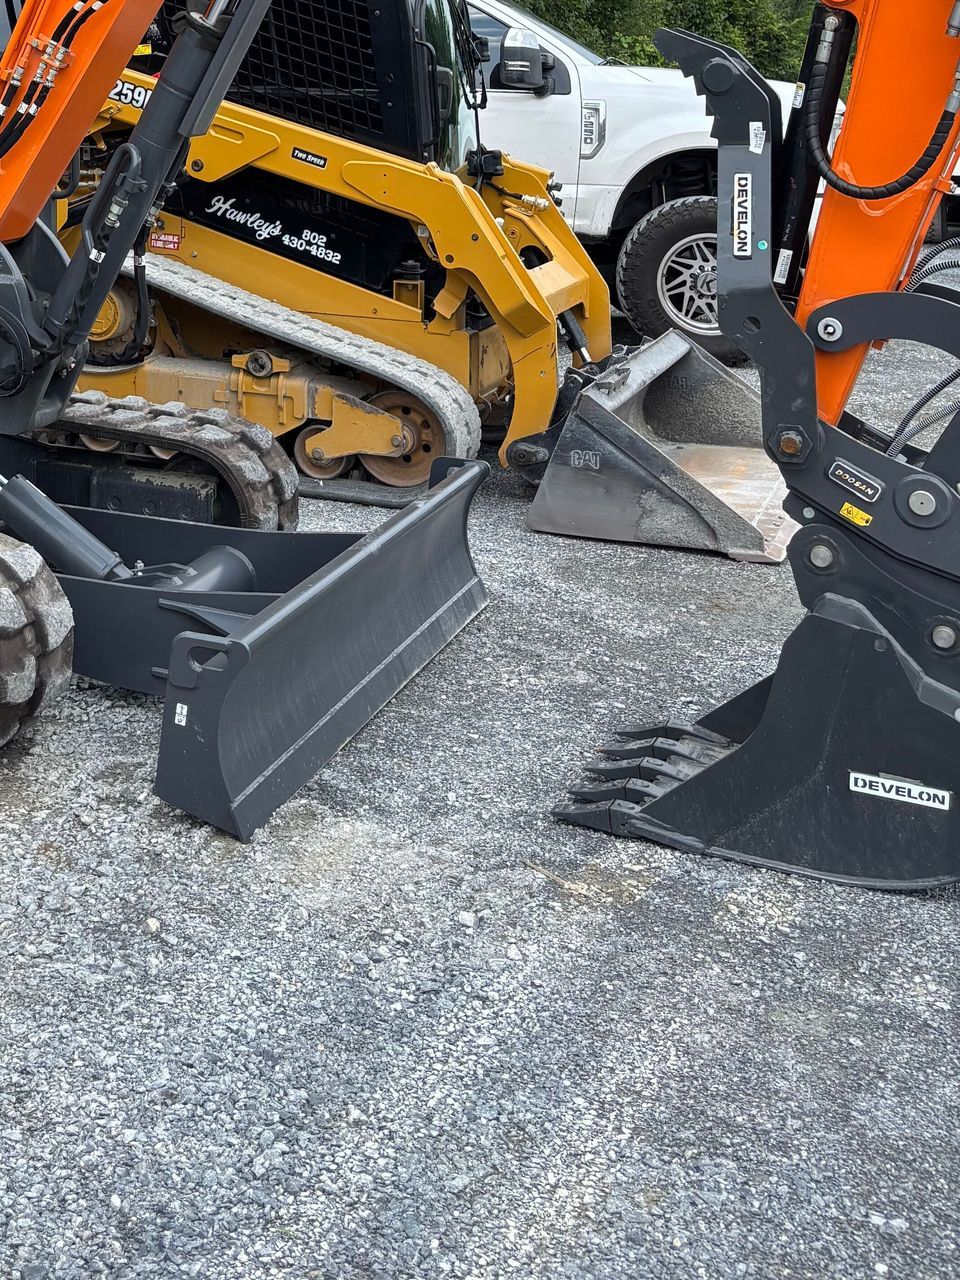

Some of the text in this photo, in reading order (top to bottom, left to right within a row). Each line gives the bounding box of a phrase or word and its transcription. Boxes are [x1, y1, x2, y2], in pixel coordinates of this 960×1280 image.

[108, 79, 153, 110] 259
[205, 195, 283, 240] Hawley's
[737, 176, 749, 253] DEVELON
[281, 234, 342, 265] 430-4832
[301, 229, 327, 247] 802
[570, 449, 601, 470] CAT
[835, 469, 875, 495] DOOSAN
[853, 776, 946, 806] DEVELON
